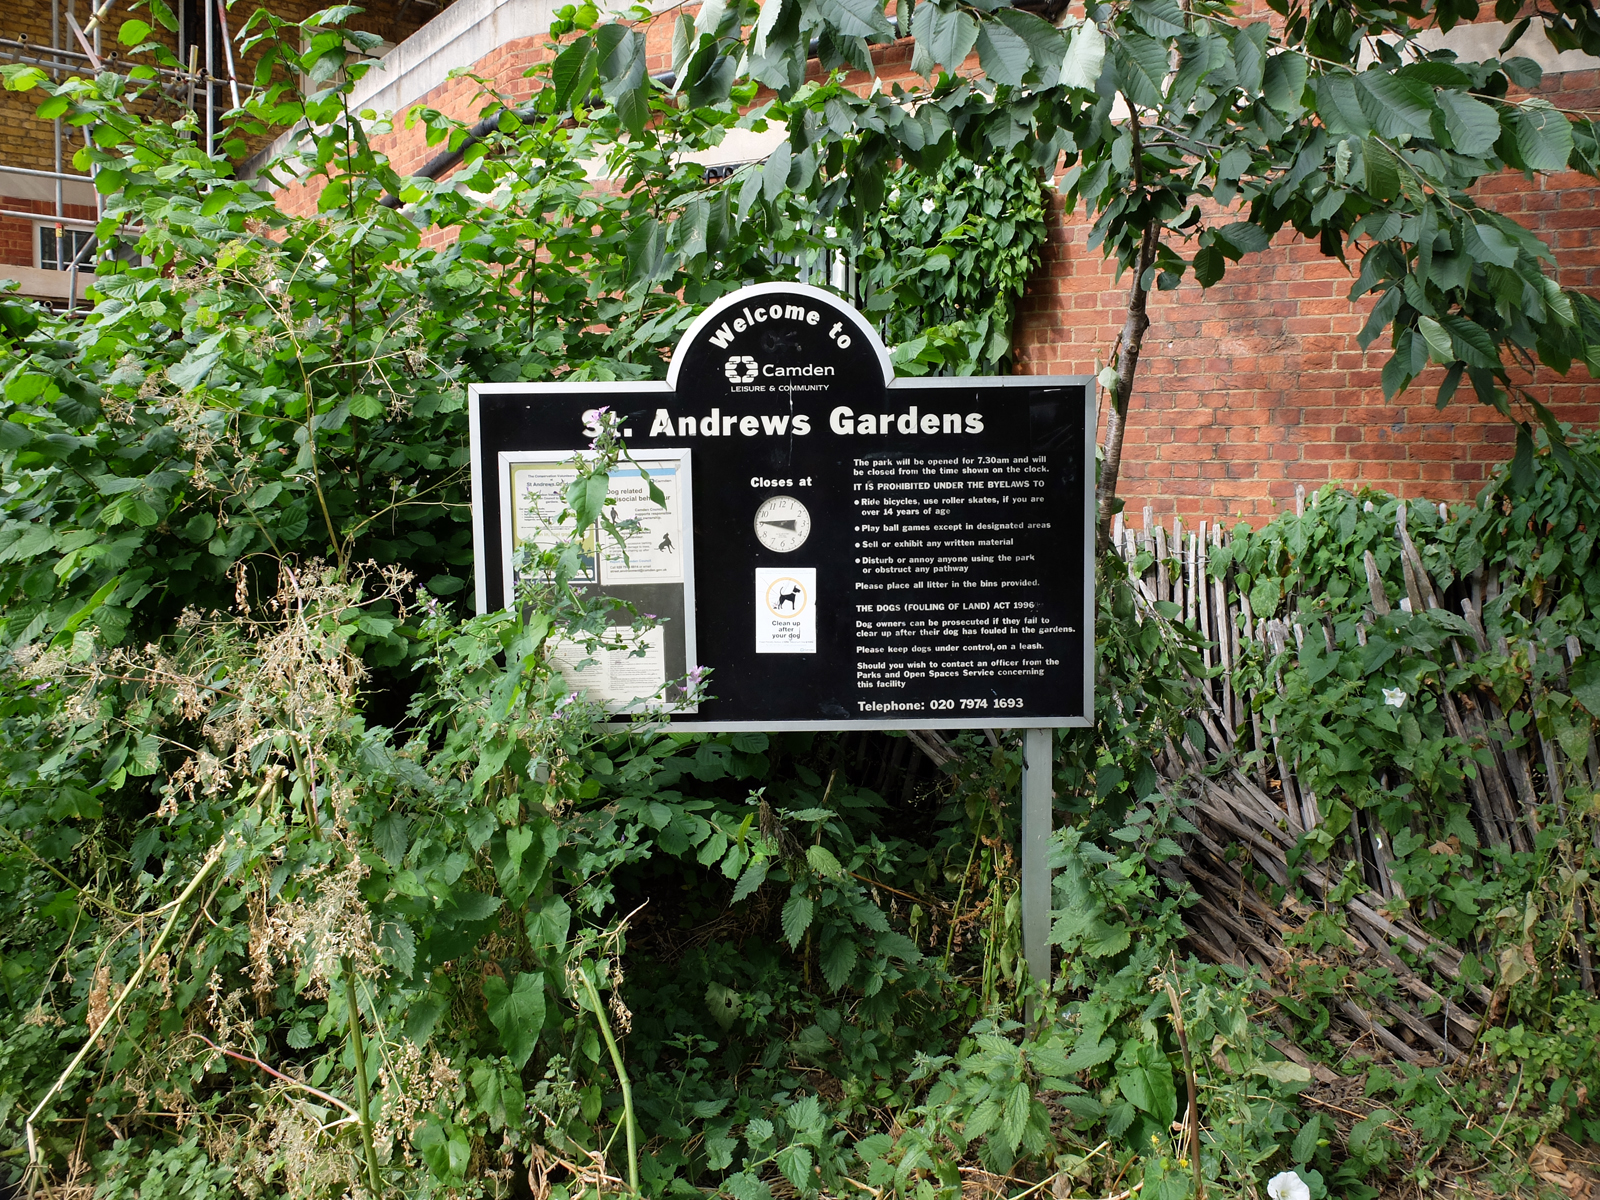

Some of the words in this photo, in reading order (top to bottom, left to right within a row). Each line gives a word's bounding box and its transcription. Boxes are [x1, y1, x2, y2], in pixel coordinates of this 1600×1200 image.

[708, 304, 820, 349] Welcome
[829, 321, 851, 349] to
[762, 364, 834, 376] Camden
[582, 409, 632, 438] St.
[649, 408, 811, 437] Andrews
[829, 406, 984, 436] Gardens
[873, 459, 892, 467] park
[928, 458, 958, 466] opened
[750, 476, 793, 488] Closes
[798, 476, 812, 487] at
[865, 481, 874, 490] IS
[878, 482, 930, 490] PROHIBITED
[988, 480, 1029, 488] BYELAWS
[884, 498, 920, 506] bicycles,
[968, 496, 999, 504] skates,
[862, 524, 880, 533] Play
[977, 522, 1023, 530] designated
[1016, 554, 1034, 562] park
[934, 565, 968, 573] pathway
[856, 582, 883, 590] Please
[887, 582, 909, 590] place
[1002, 580, 1039, 588] provided.
[877, 604, 900, 612] DOGS
[904, 603, 944, 612] (FOULING
[963, 602, 990, 610] LAND)
[942, 618, 989, 627] prosecuted
[943, 628, 958, 636] dog
[1039, 626, 1075, 634] gardens.
[912, 645, 931, 653] dogs
[904, 670, 925, 678] Open
[929, 670, 959, 678] Spaces
[998, 668, 1044, 676] concerning
[877, 680, 906, 688] facility
[858, 701, 924, 712] Telephone:
[930, 700, 954, 710] 020
[960, 699, 988, 709] 7974
[994, 698, 1023, 708] 1693
